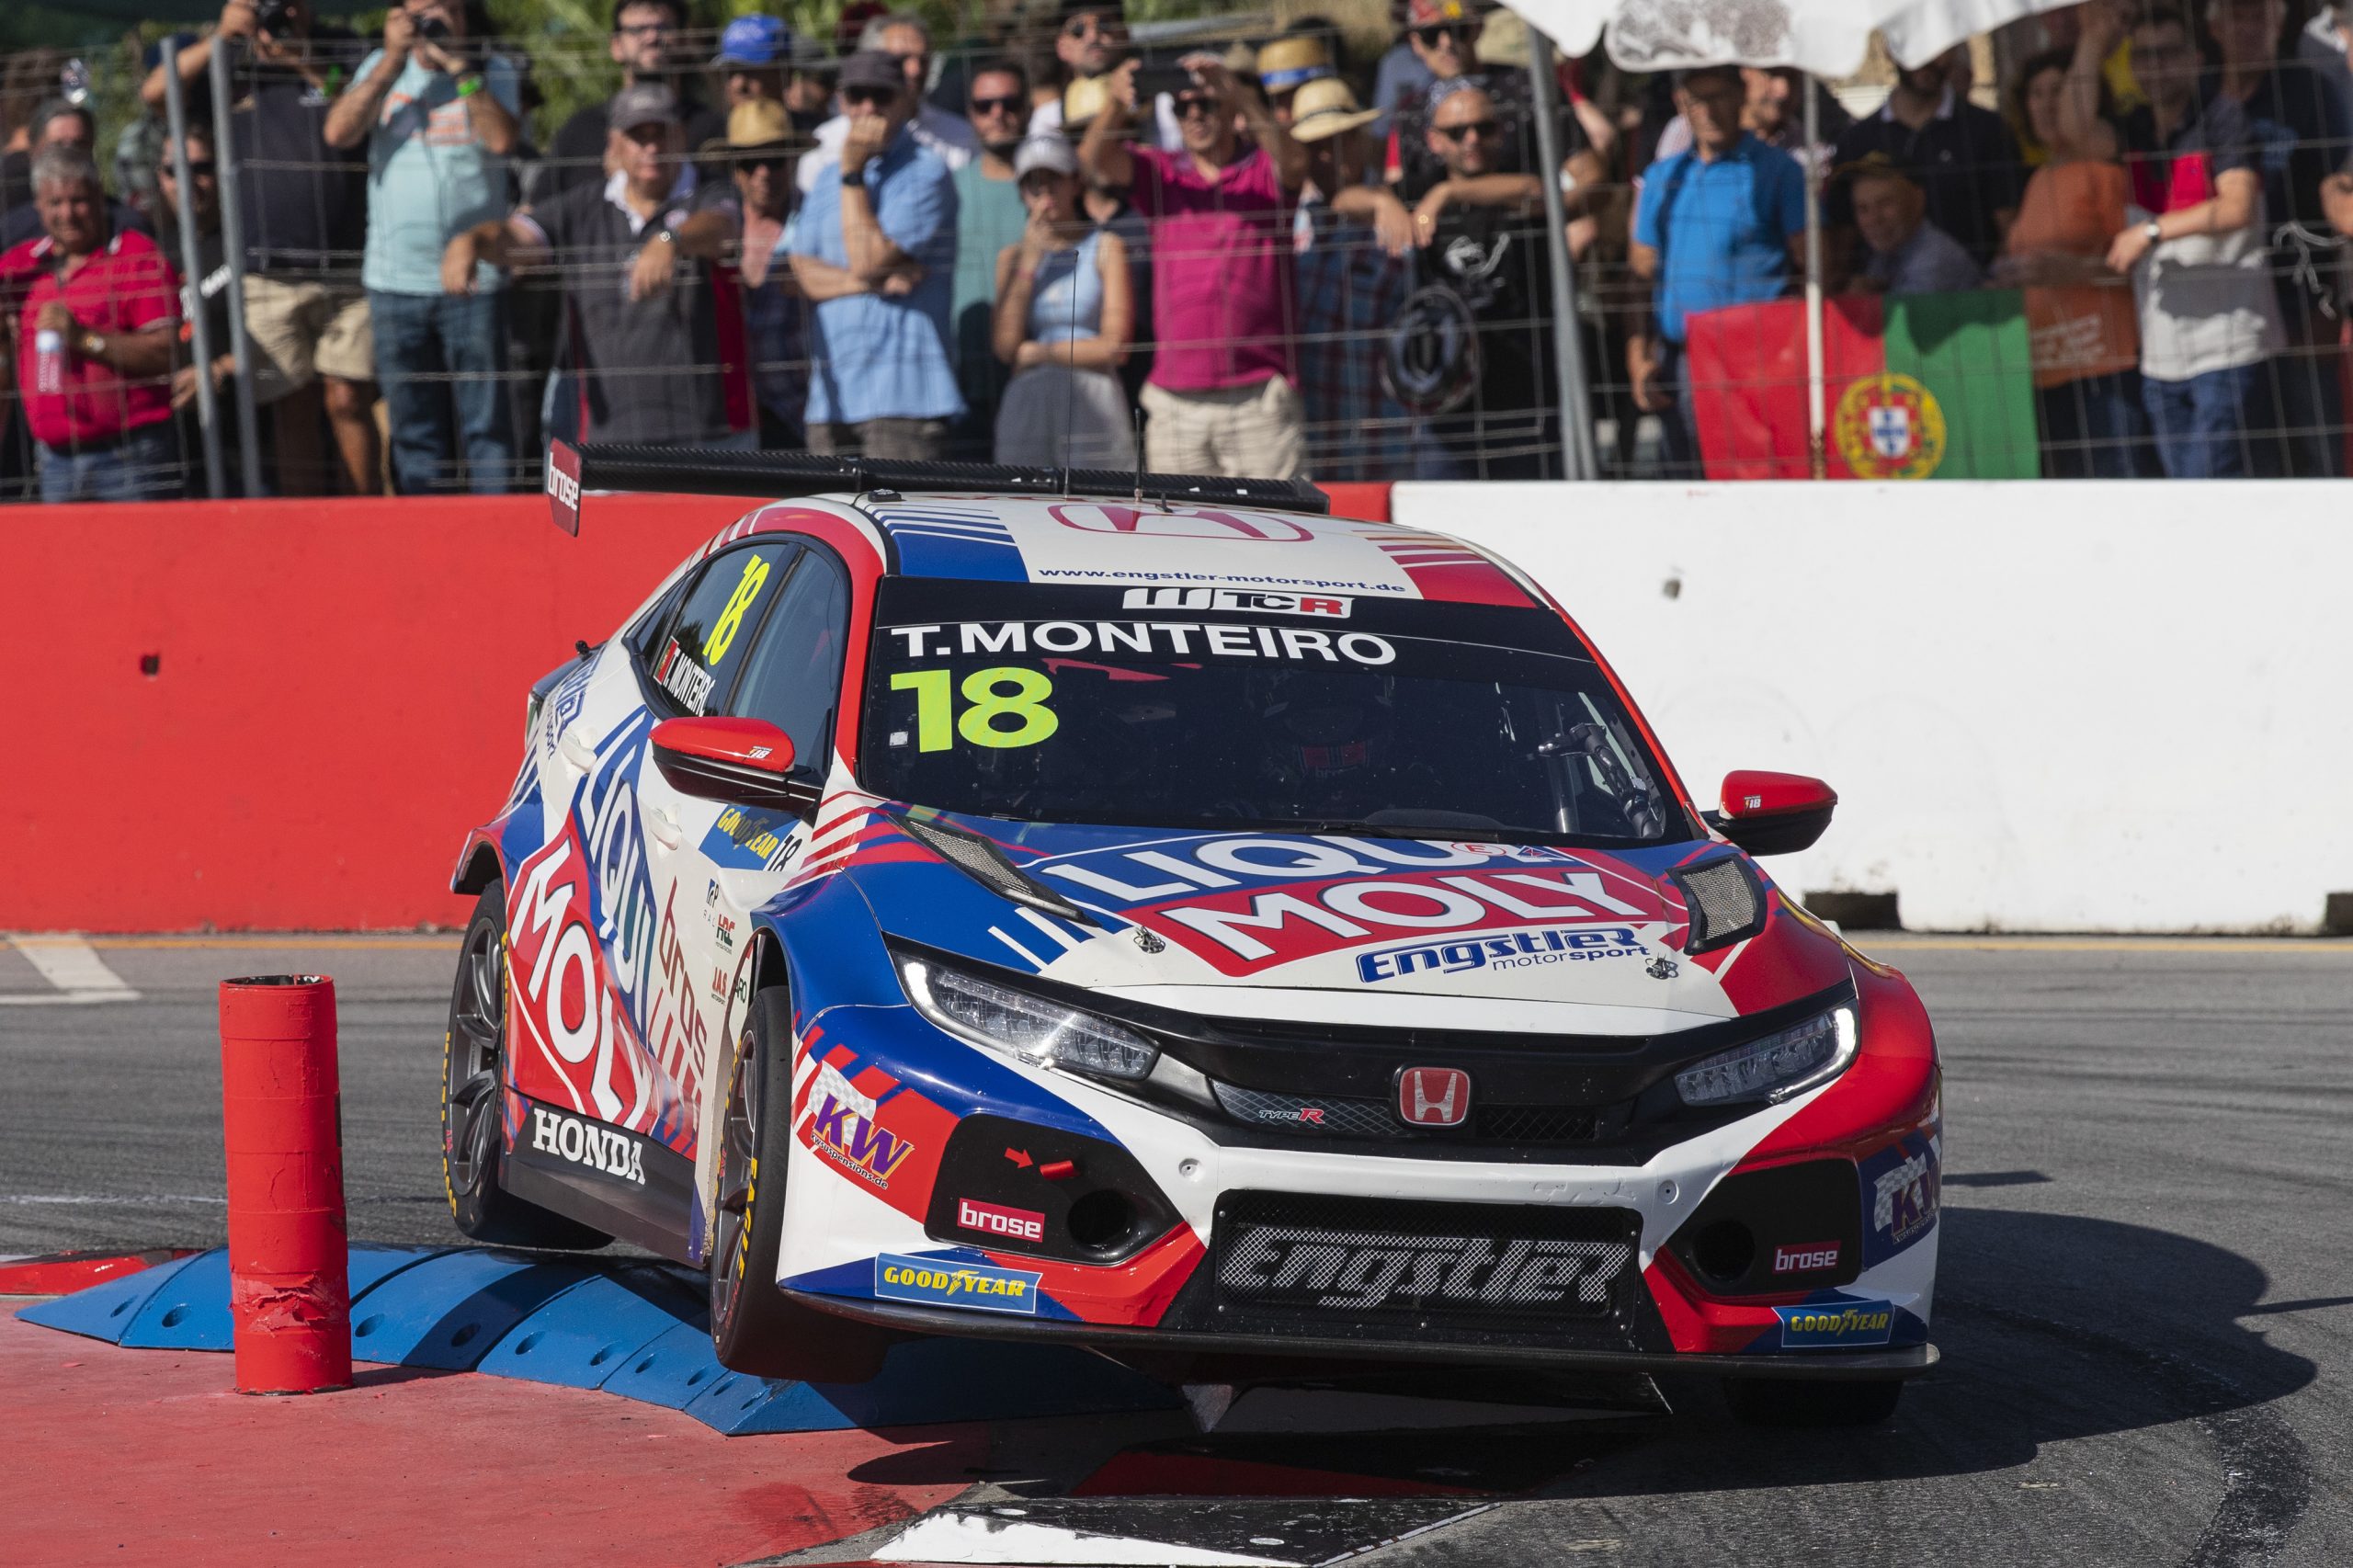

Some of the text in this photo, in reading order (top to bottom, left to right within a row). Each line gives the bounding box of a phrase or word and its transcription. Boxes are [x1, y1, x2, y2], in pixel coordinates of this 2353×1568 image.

[547, 451, 579, 511] brose
[1038, 568, 1406, 593] www.engstler-motorsport.de
[1122, 587, 1355, 619] WTCR
[702, 554, 770, 665] 18
[890, 621, 1396, 665] T.MONTEIRO
[890, 667, 1059, 753] 18
[717, 808, 779, 859] GOODYEAR
[767, 834, 802, 872] 18
[1161, 872, 1648, 962] MOLY
[1356, 928, 1642, 983] Engstler
[1493, 945, 1651, 971] motorsport
[712, 967, 728, 998] JAS
[532, 1108, 646, 1186] HONDA
[813, 1092, 915, 1181] KW
[811, 1131, 889, 1190] kwsuspensions.de
[960, 1200, 1041, 1239] brose
[884, 1266, 1027, 1299] GOODYEAR
[1219, 1225, 1633, 1310] Engstler
[1775, 1247, 1838, 1272] brose
[1790, 1310, 1889, 1336] GOODYEAR
